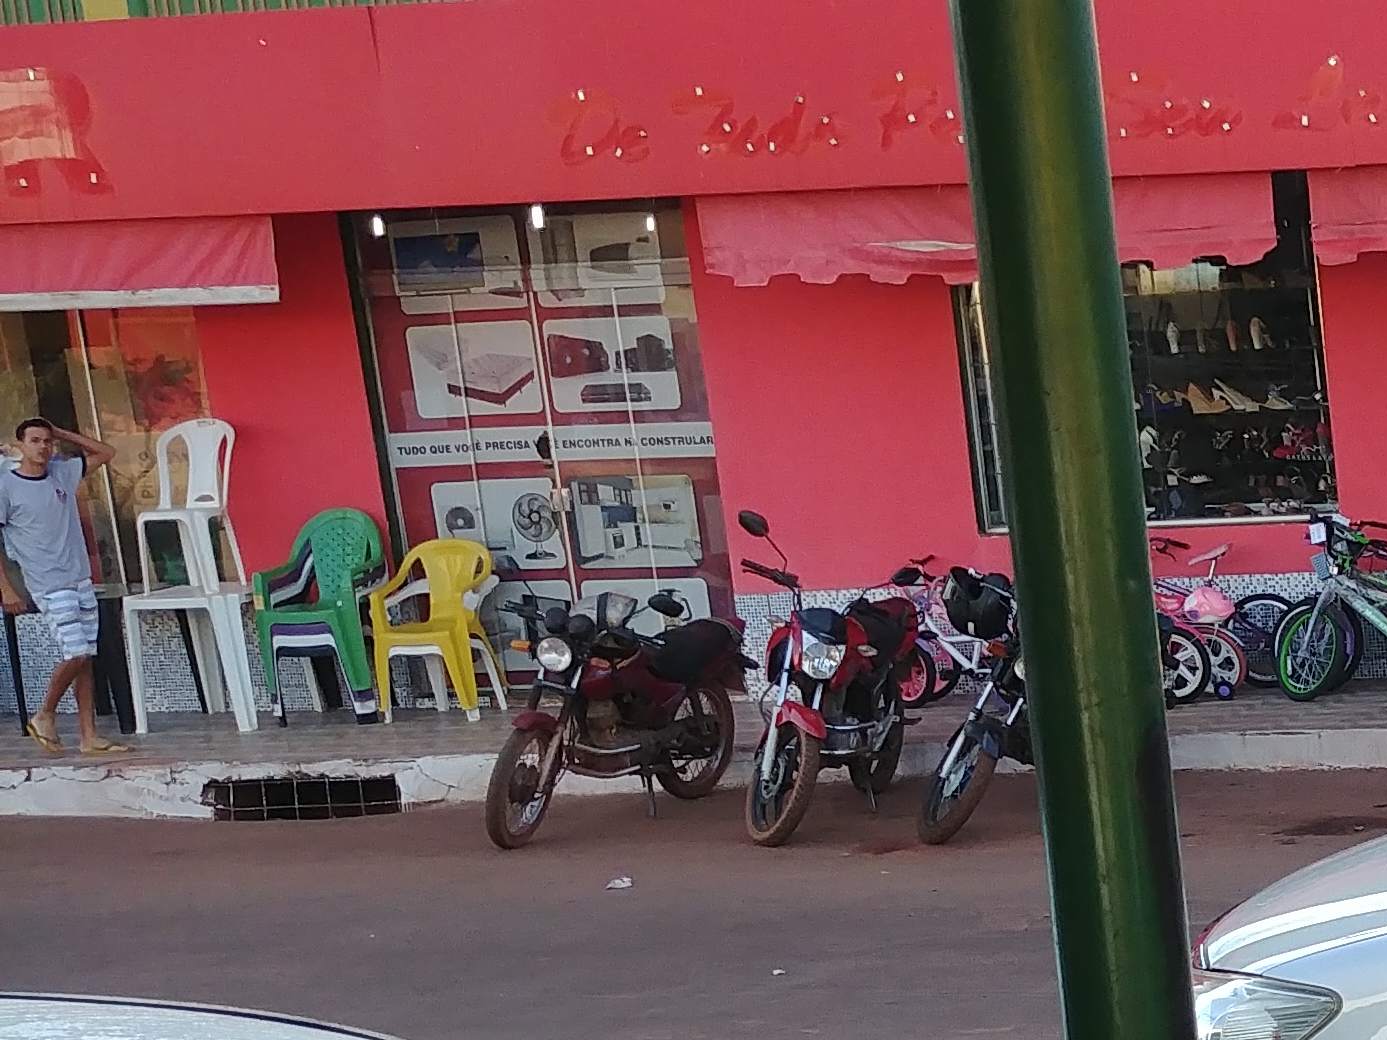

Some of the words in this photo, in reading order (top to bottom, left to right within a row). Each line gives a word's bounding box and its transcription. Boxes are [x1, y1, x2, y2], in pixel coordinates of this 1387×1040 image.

[397, 445, 427, 456] TUDO
[429, 444, 451, 455] QUE
[485, 440, 530, 451] PRECISA
[562, 438, 621, 449] ENCONTRA
[624, 437, 639, 447] N
[641, 435, 714, 447] CONSTRULAR
